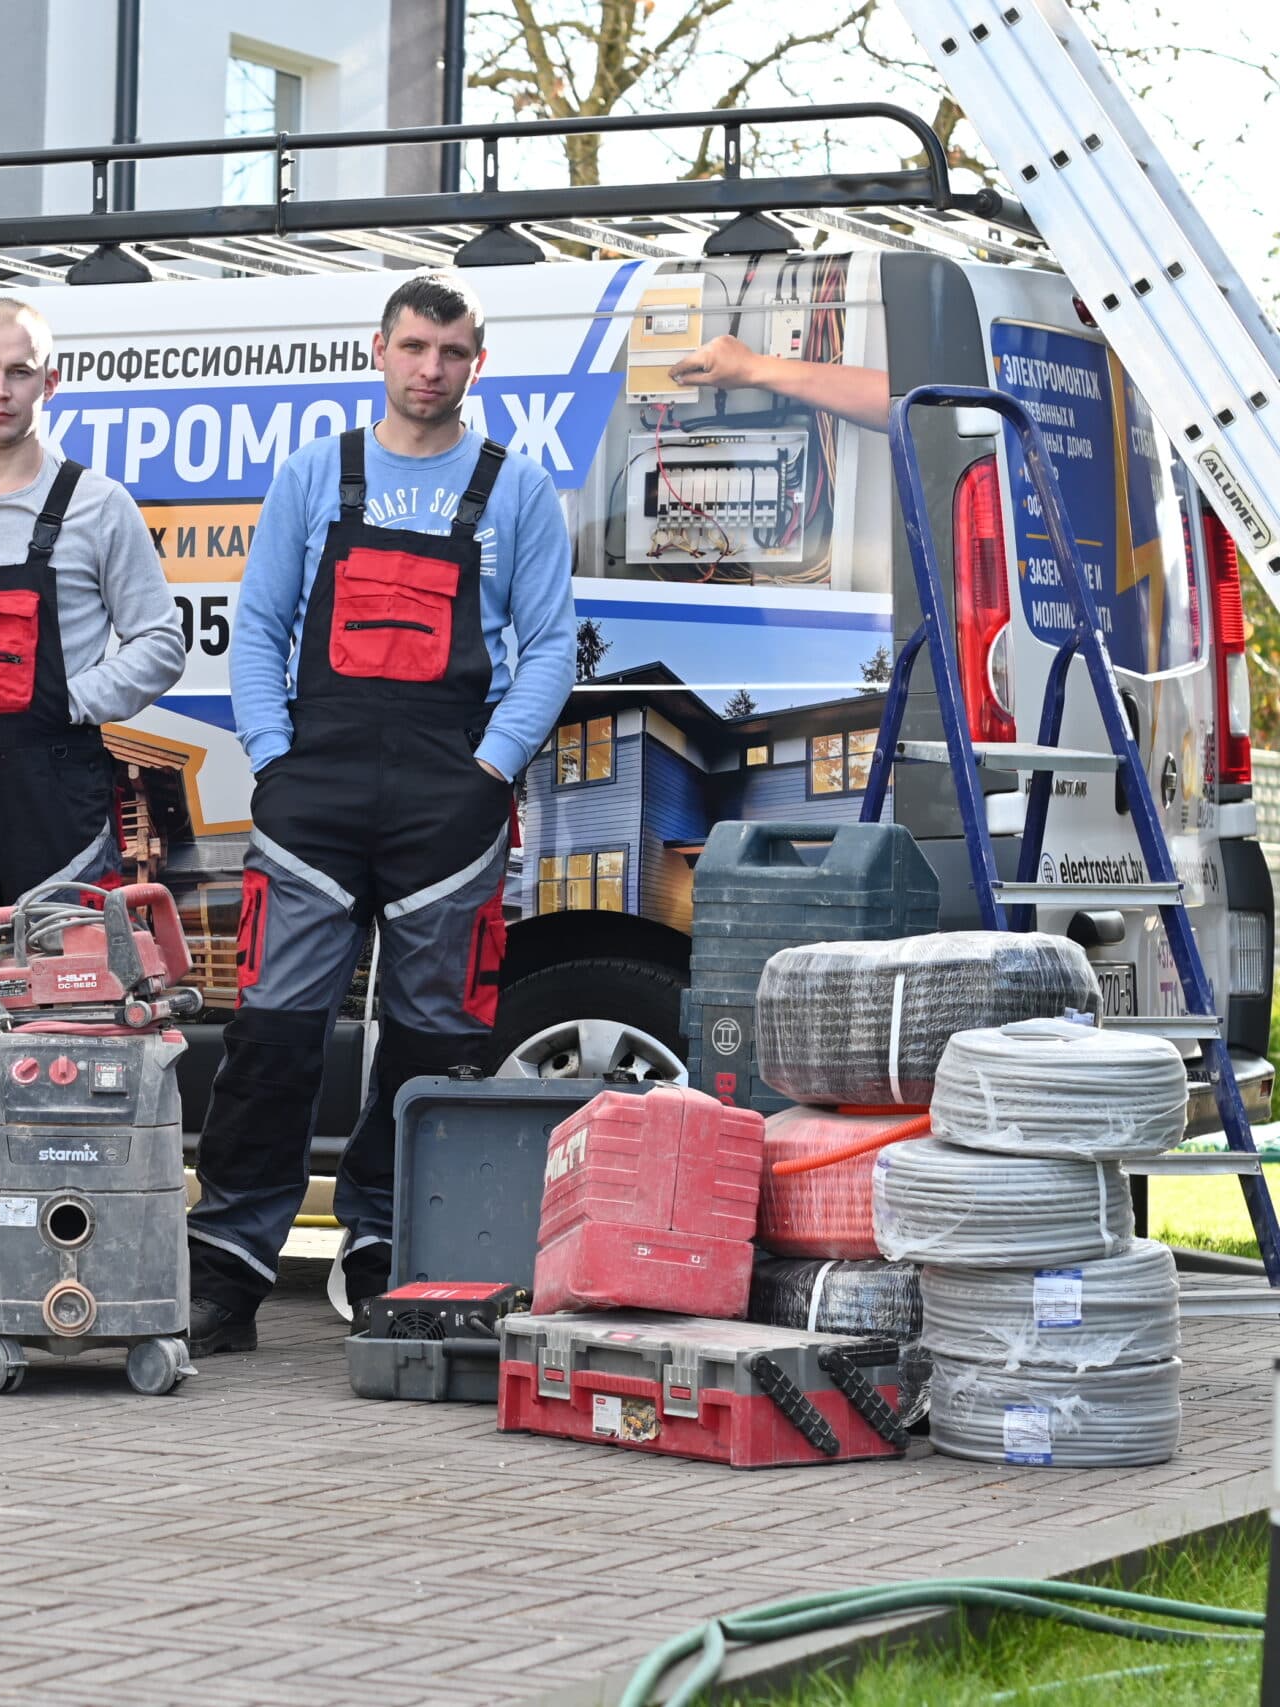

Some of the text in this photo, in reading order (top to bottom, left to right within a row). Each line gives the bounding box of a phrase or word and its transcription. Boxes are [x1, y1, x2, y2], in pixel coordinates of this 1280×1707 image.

[1003, 353, 1102, 401] ЭЛЕКТРОМОНТАЖ
[1201, 458, 1266, 541] ALUMET
[177, 526, 197, 558] И
[1060, 853, 1144, 884] electrostart.by
[38, 1143, 99, 1161] starmix
